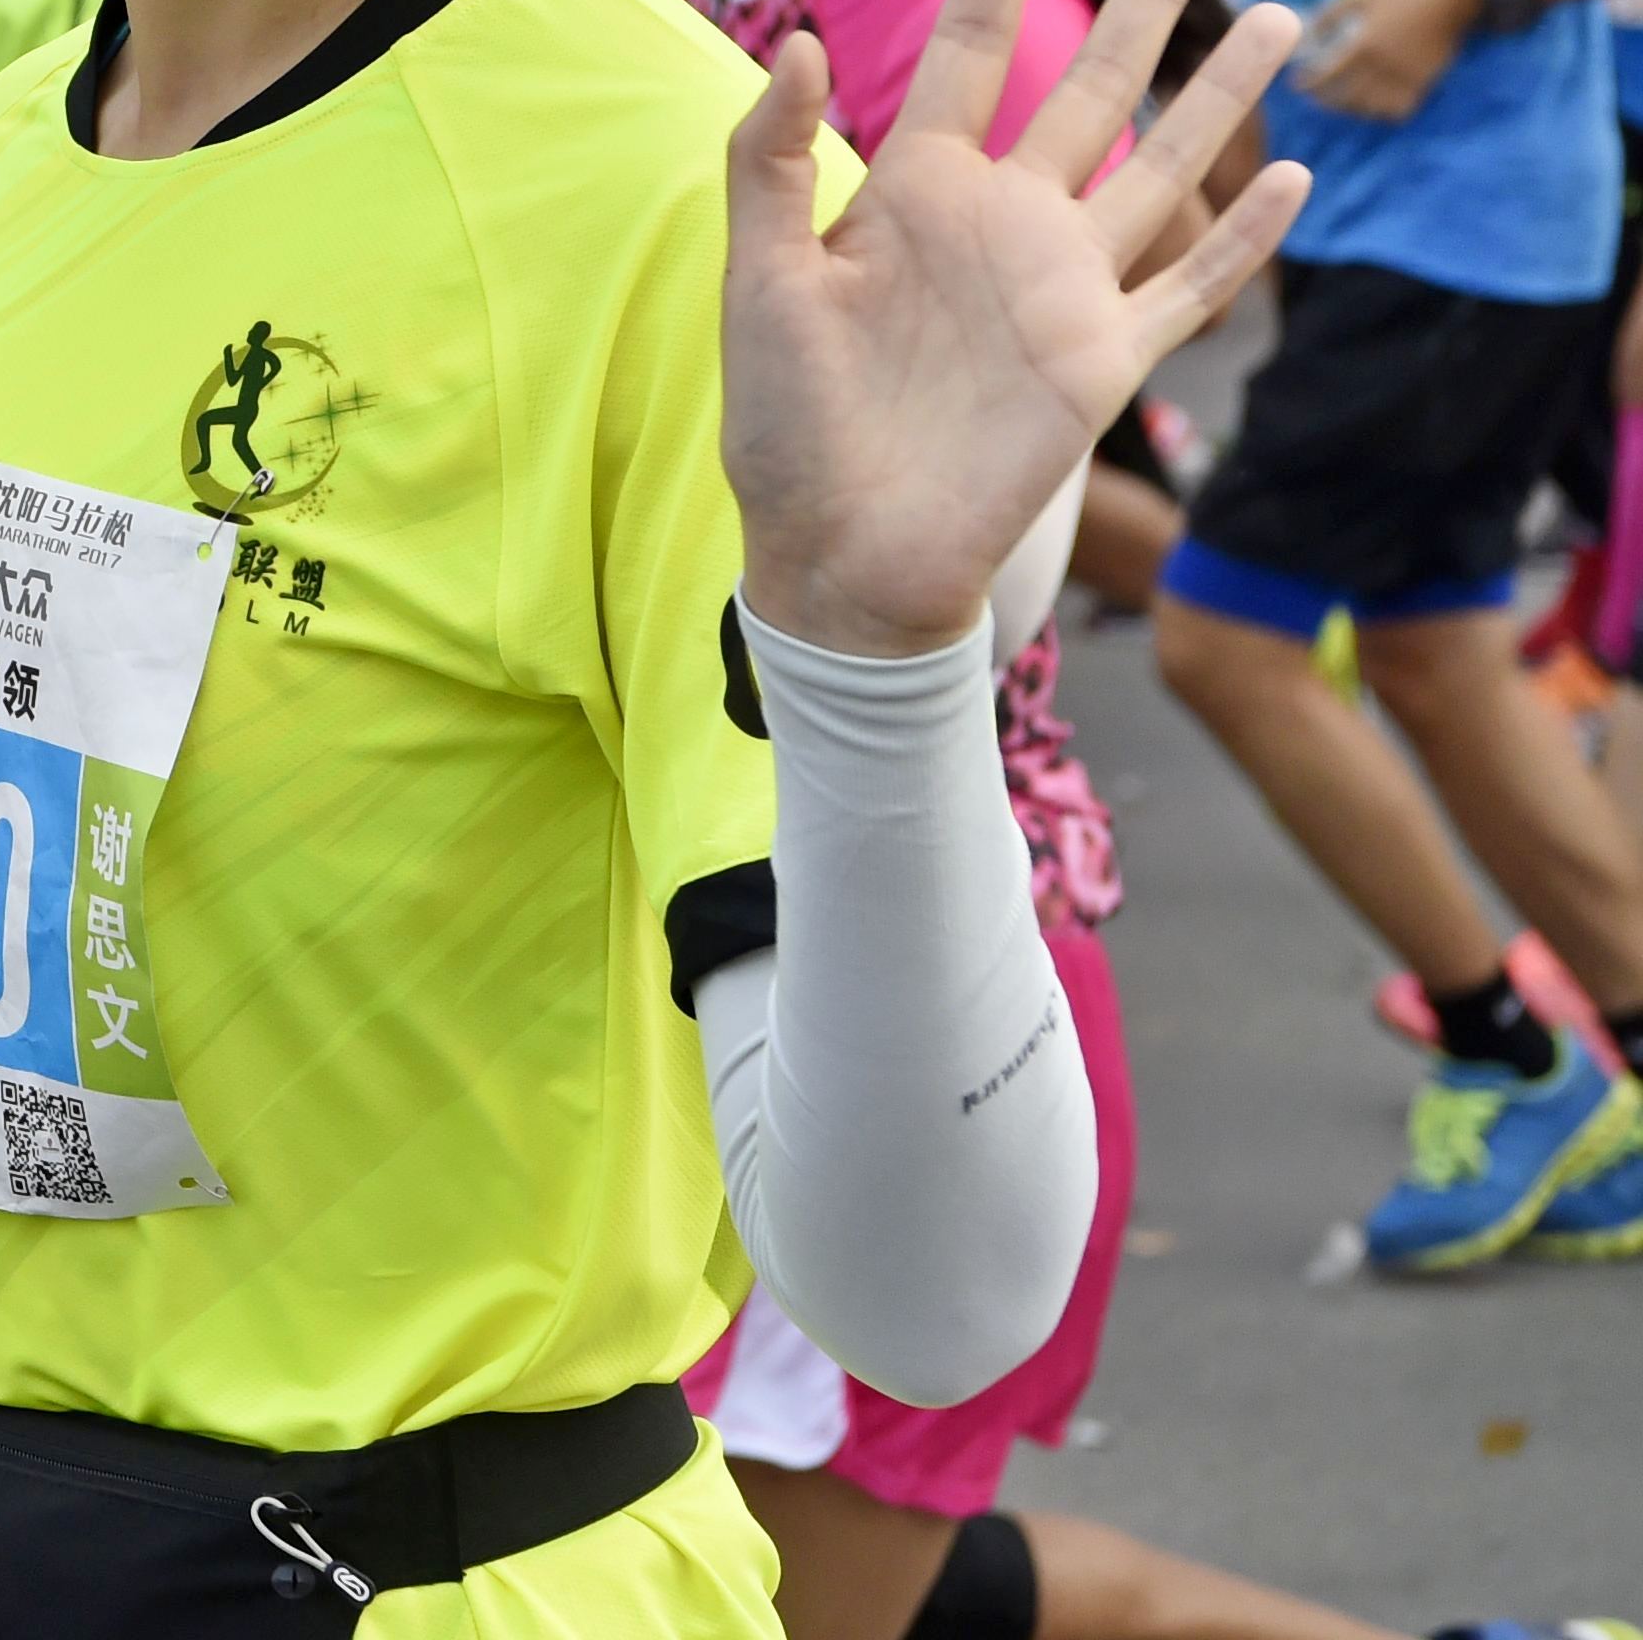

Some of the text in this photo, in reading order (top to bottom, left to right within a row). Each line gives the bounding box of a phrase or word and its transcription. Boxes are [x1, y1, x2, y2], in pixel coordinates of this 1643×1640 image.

[78, 545, 123, 569] 2017
[84, 802, 148, 1060] 谢思文
